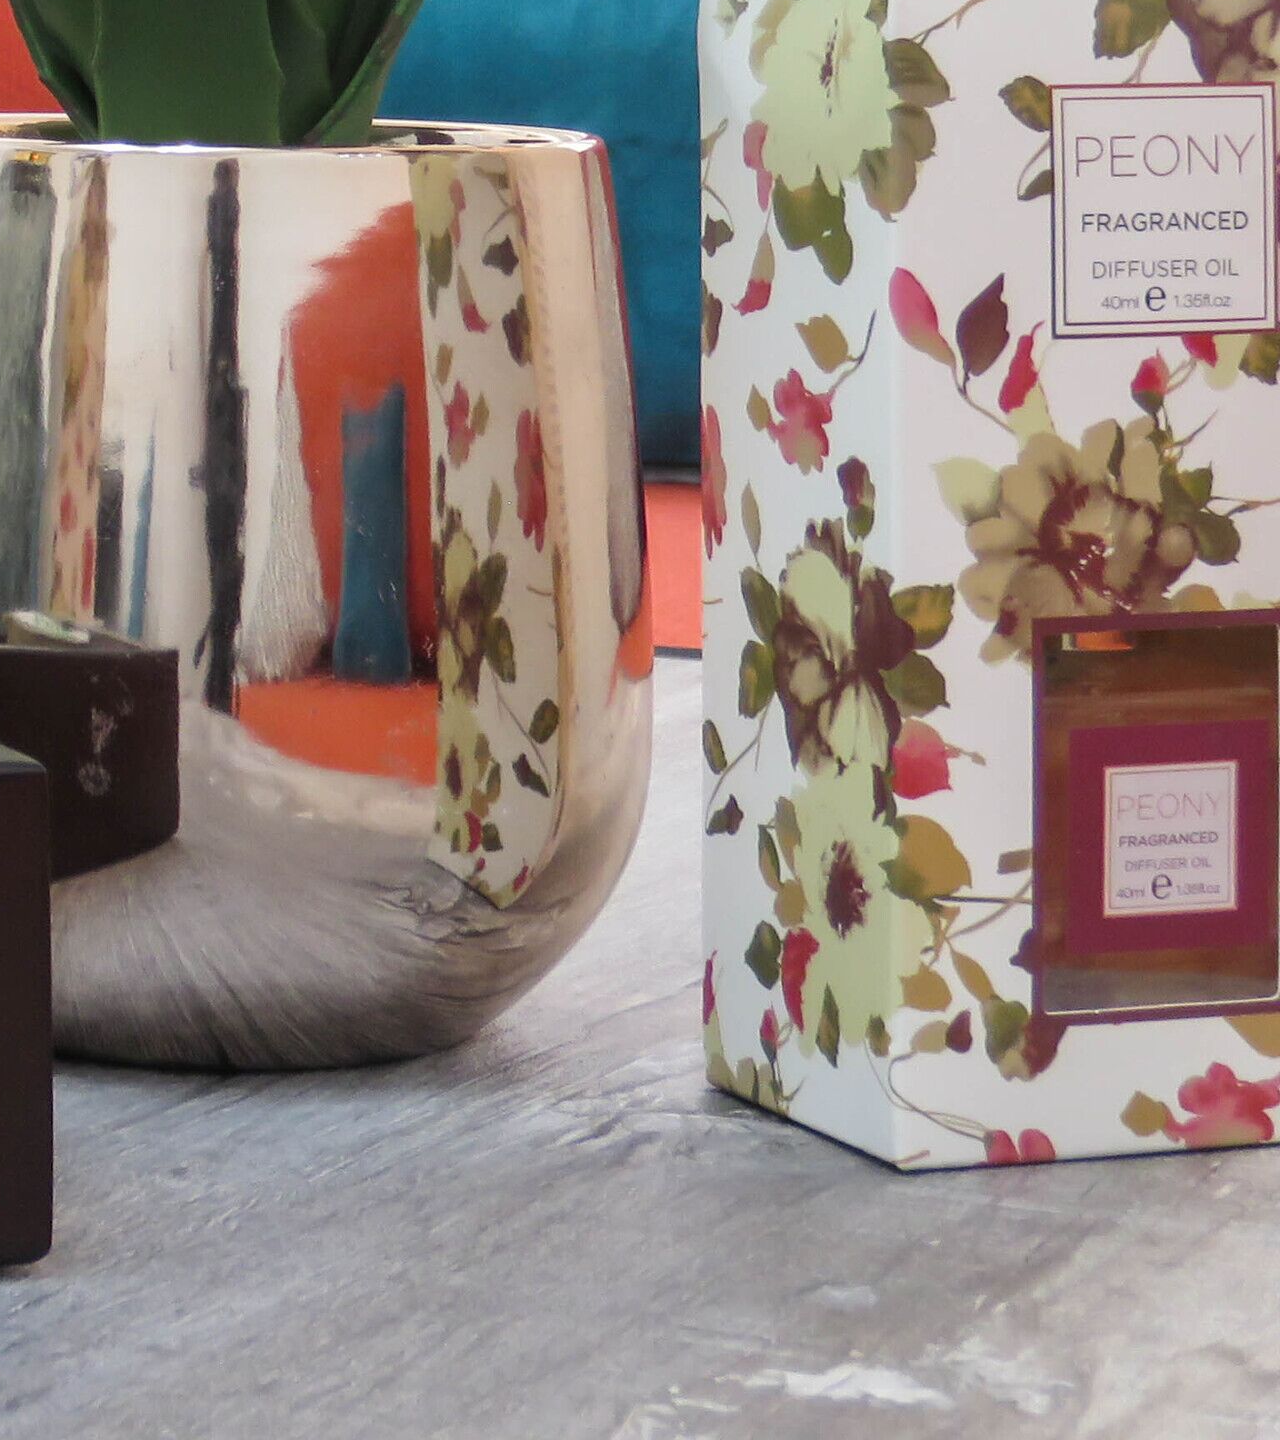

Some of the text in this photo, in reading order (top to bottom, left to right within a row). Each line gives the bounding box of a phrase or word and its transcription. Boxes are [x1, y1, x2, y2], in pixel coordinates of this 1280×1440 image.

[1075, 134, 1256, 177] PEONY
[1081, 211, 1249, 233] FRAGRANCED
[1092, 258, 1240, 279] DIFFUSER OIL
[1100, 295, 1140, 310] 40ml
[1117, 792, 1222, 820] PEONY
[1118, 831, 1219, 848] FRAGRANCED
[1124, 856, 1213, 872] DIFFUSER OIL
